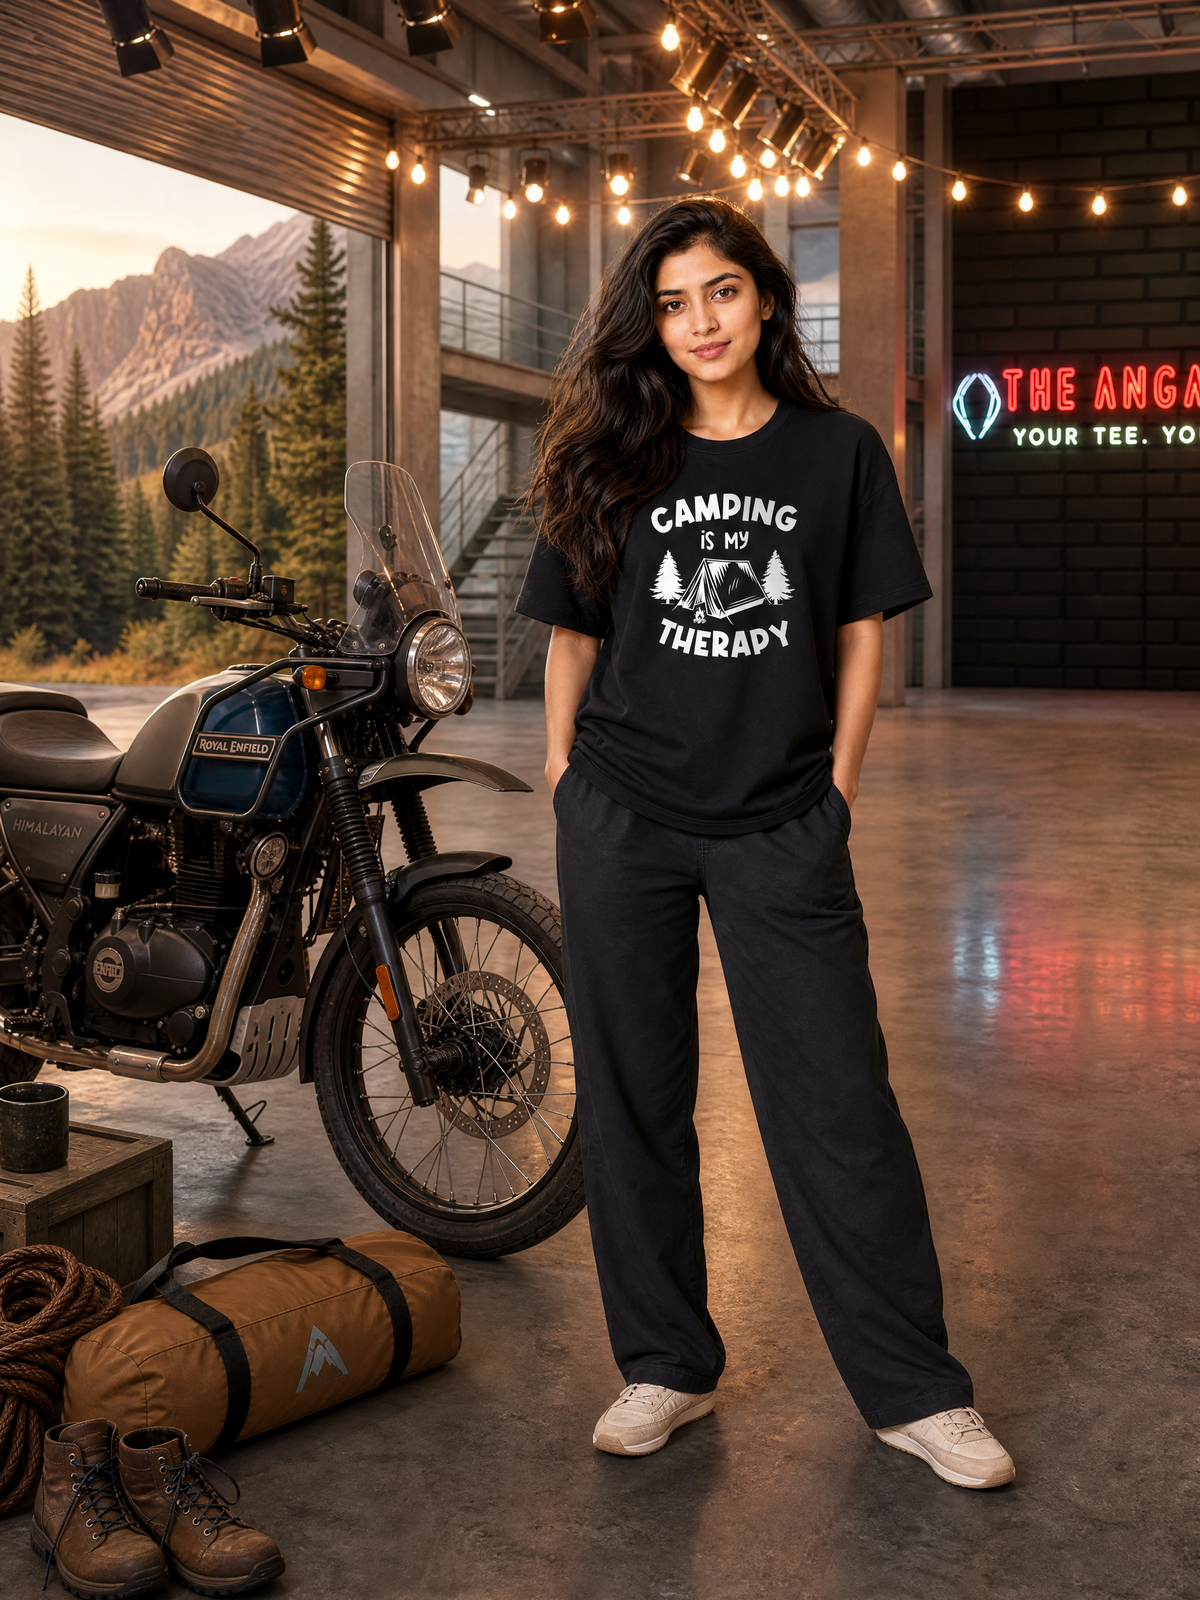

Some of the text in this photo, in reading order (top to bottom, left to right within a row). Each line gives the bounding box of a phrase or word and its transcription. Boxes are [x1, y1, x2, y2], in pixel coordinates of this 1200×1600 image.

[1002, 364, 1200, 412] THE ANGA
[1013, 425, 1200, 446] YOUR TEE. YO
[650, 493, 798, 533] CAMPING
[658, 617, 789, 658] THERAPY
[199, 738, 269, 754] ROYAL ENFIELD
[12, 818, 82, 839] HIMALAYAN
